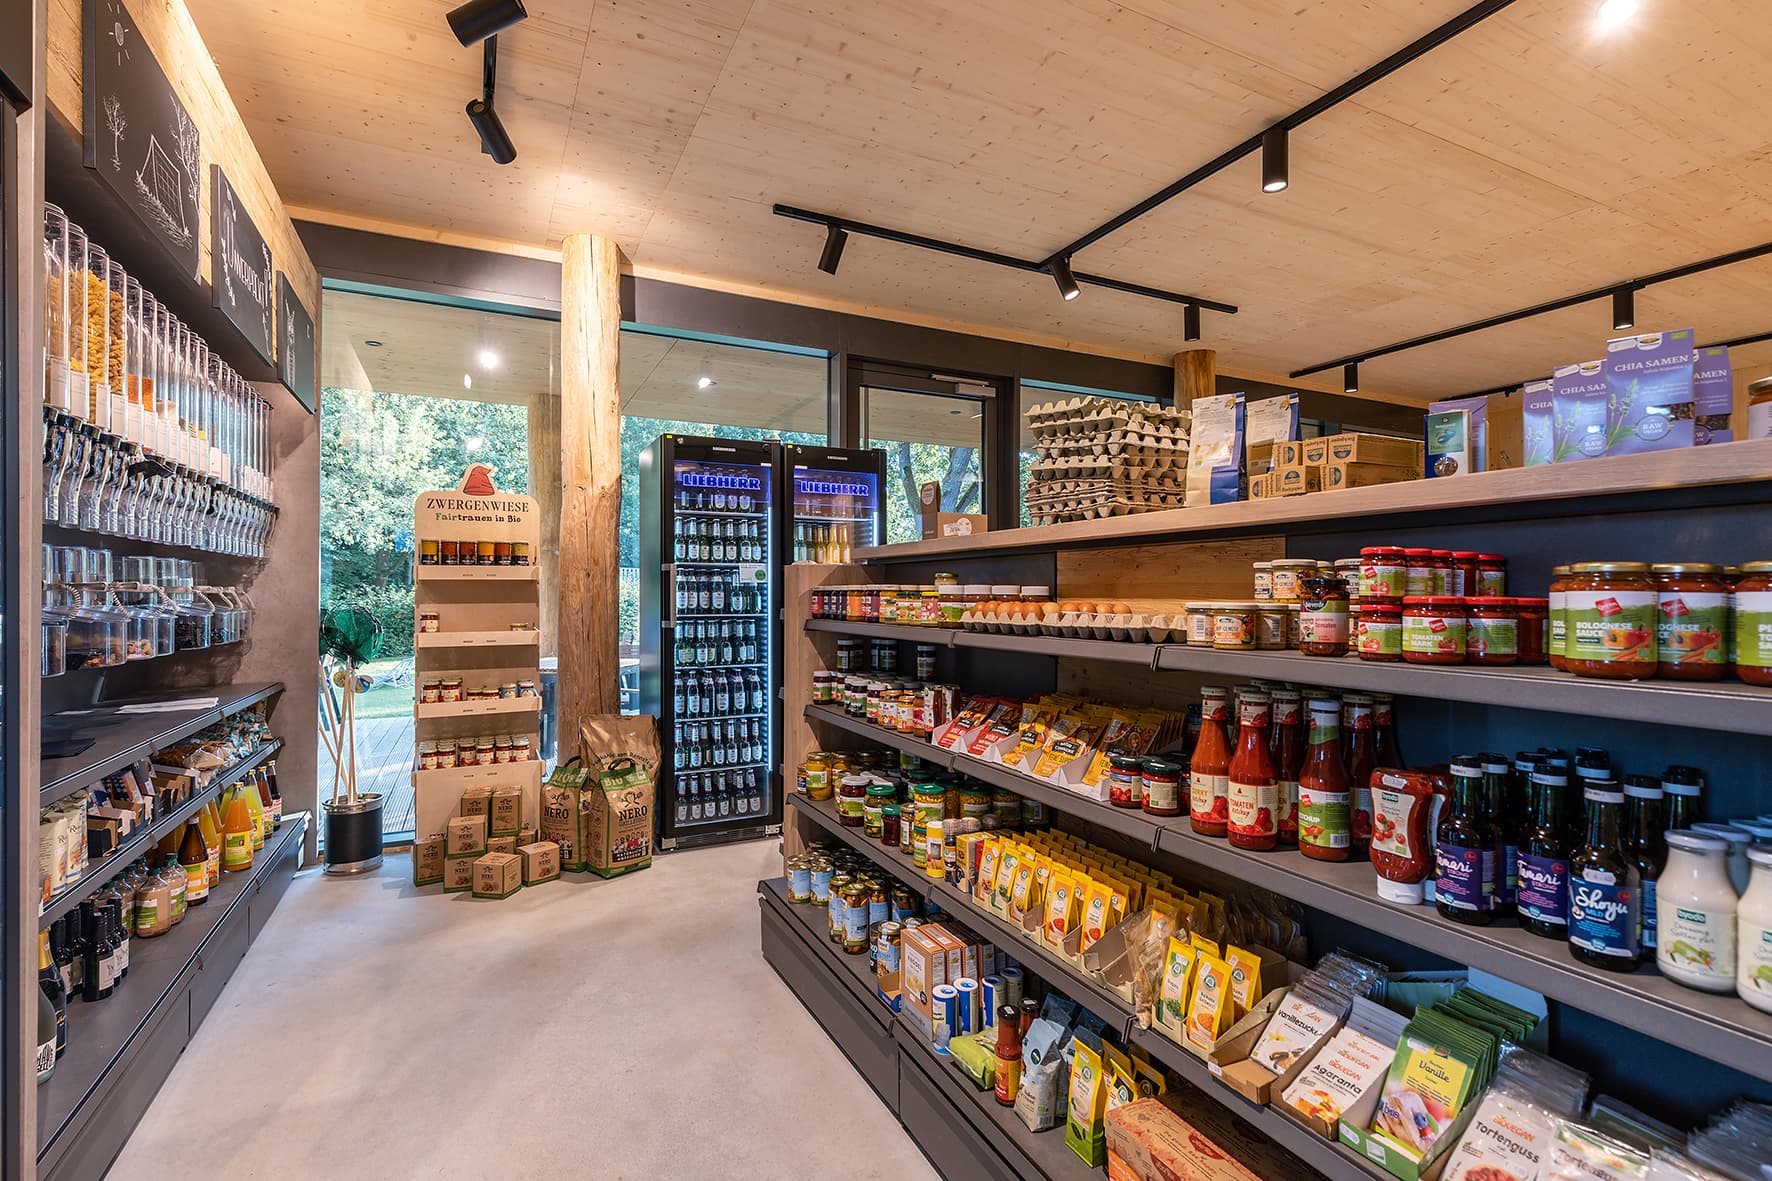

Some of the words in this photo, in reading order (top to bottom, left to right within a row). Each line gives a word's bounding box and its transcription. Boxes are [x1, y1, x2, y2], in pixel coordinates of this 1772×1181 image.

[1614, 363, 1643, 372] CHIA
[1645, 355, 1688, 368] SAMEN
[1560, 387, 1585, 396] CHIA
[1587, 383, 1607, 394] SAM
[1530, 401, 1552, 409] CHIA
[683, 474, 760, 490] LIEBHERR
[800, 480, 868, 496] LIEBHERR
[427, 498, 529, 512] ZWERGENWIESE
[436, 513, 492, 522] Fairtrauen
[508, 515, 522, 523] Bio
[1576, 622, 1632, 630] BOLOGNESE
[1230, 798, 1254, 810] TOMATEN
[544, 806, 569, 820] NERO
[619, 805, 648, 820] NERO
[1575, 886, 1628, 920] Shoyu
[1328, 1060, 1360, 1080] BIOVEGAN
[1418, 1060, 1450, 1083] Vanille
[1313, 1064, 1362, 1094] Agaranta
[1492, 1114, 1536, 1142] BIOVEGAN
[1475, 1121, 1541, 1164] Tortenguss
